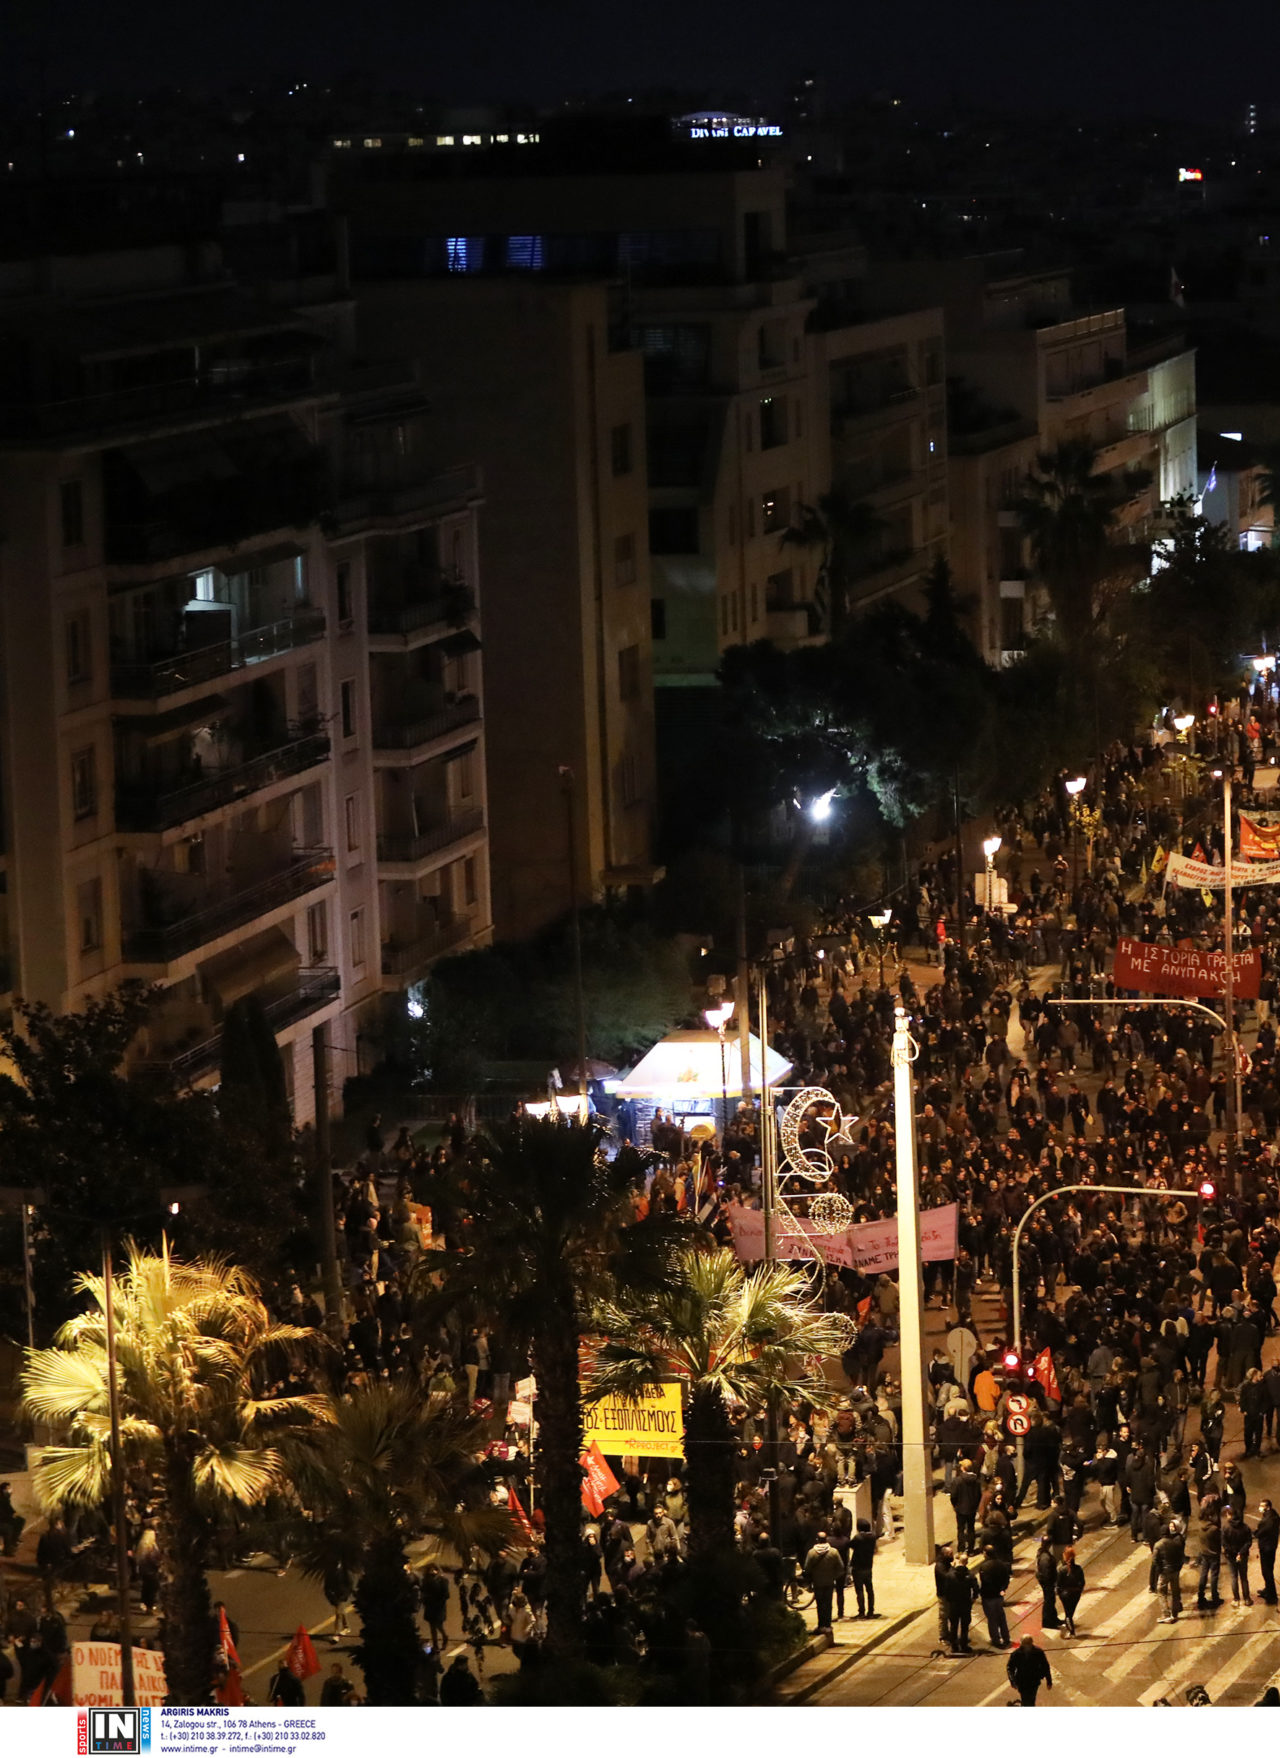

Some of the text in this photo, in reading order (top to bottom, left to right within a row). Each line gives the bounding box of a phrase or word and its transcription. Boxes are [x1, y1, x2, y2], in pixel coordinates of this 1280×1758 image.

[1121, 941, 1254, 968] Η ΙΣΤΟΡΙΑ ΓΡΑΕΤΑΙ
[1130, 957, 1241, 984] ΜΕ ΑΝΥΠΑΚΟΗ
